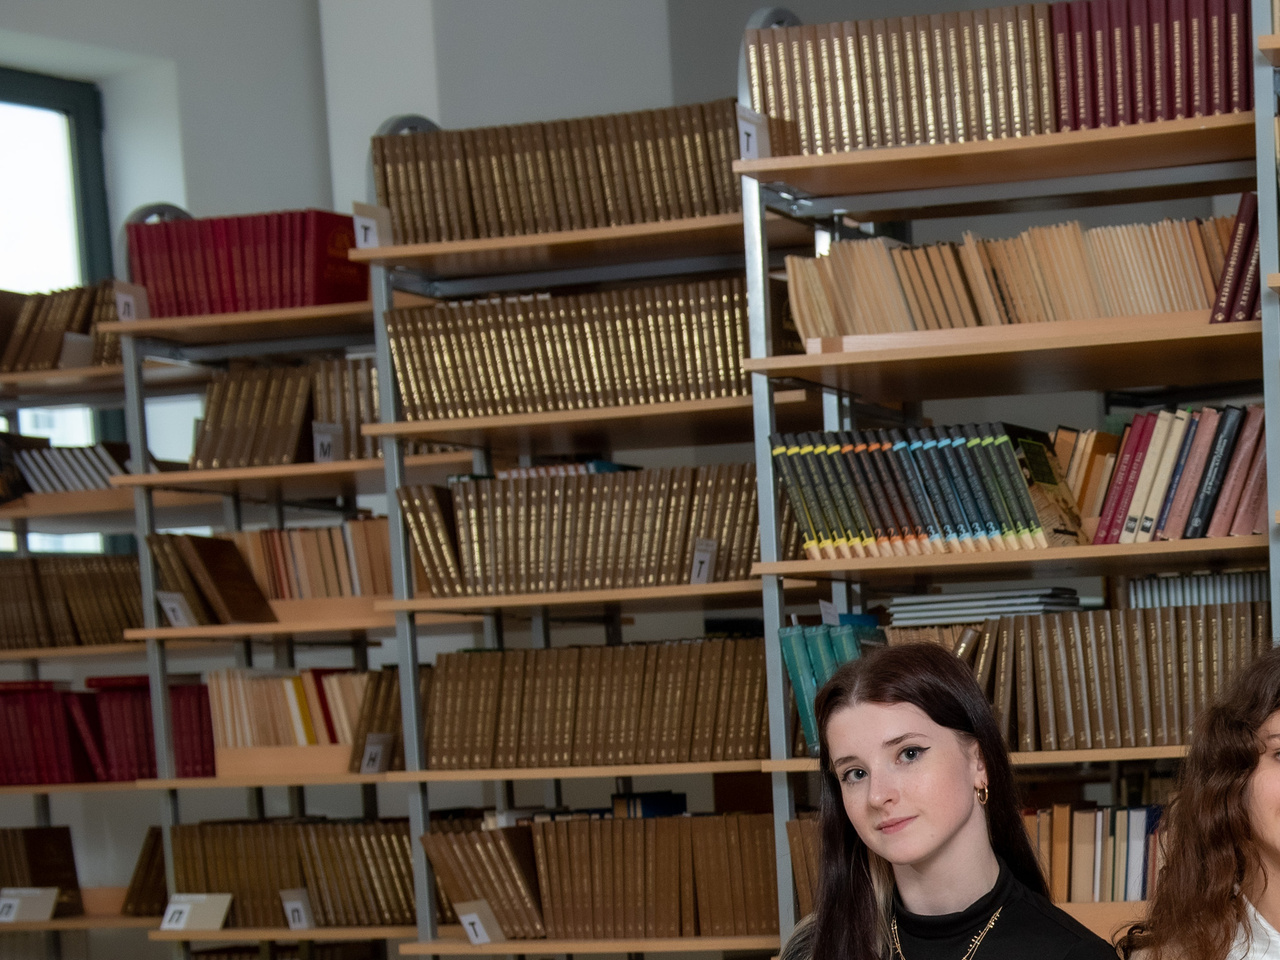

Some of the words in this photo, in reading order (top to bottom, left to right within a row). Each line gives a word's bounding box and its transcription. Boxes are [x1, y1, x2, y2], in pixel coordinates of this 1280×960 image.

[744, 132, 752, 152] Т
[361, 226, 370, 243] Т
[467, 921, 481, 938] Т
